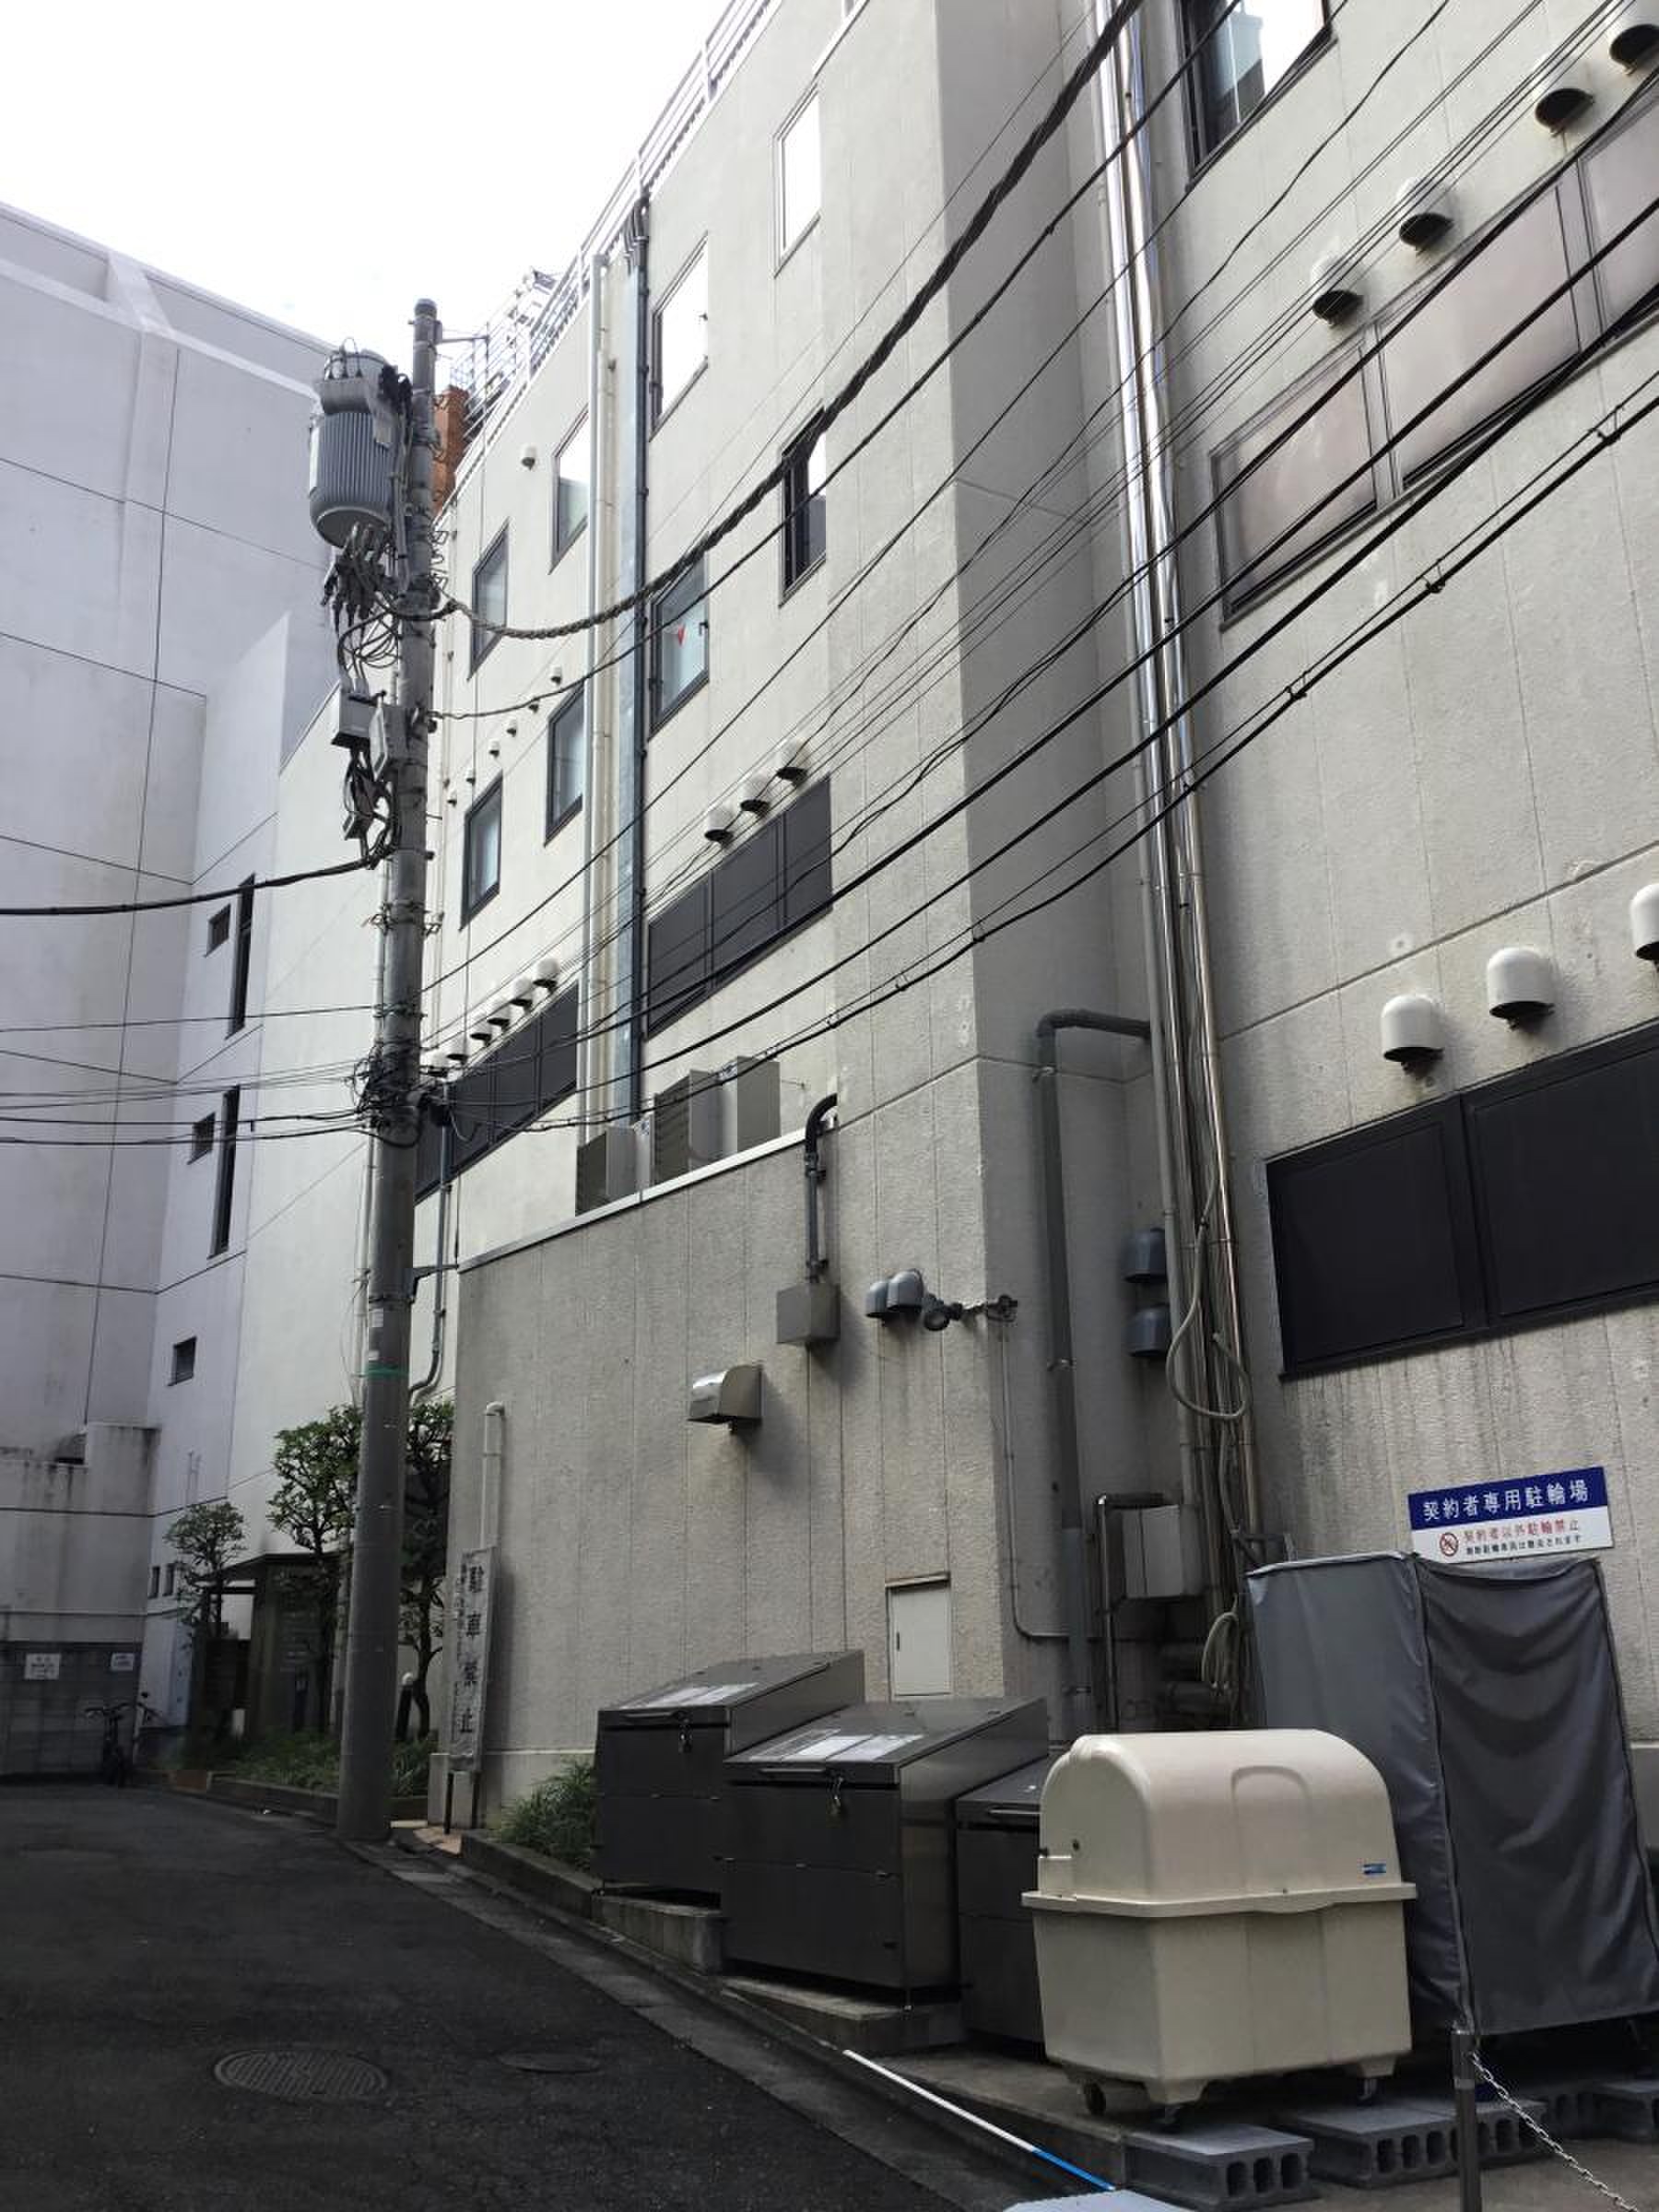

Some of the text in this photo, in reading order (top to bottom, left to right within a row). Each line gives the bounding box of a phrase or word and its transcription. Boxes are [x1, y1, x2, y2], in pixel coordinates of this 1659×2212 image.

[1423, 1479, 1589, 1522] 契約者専用駐輪場
